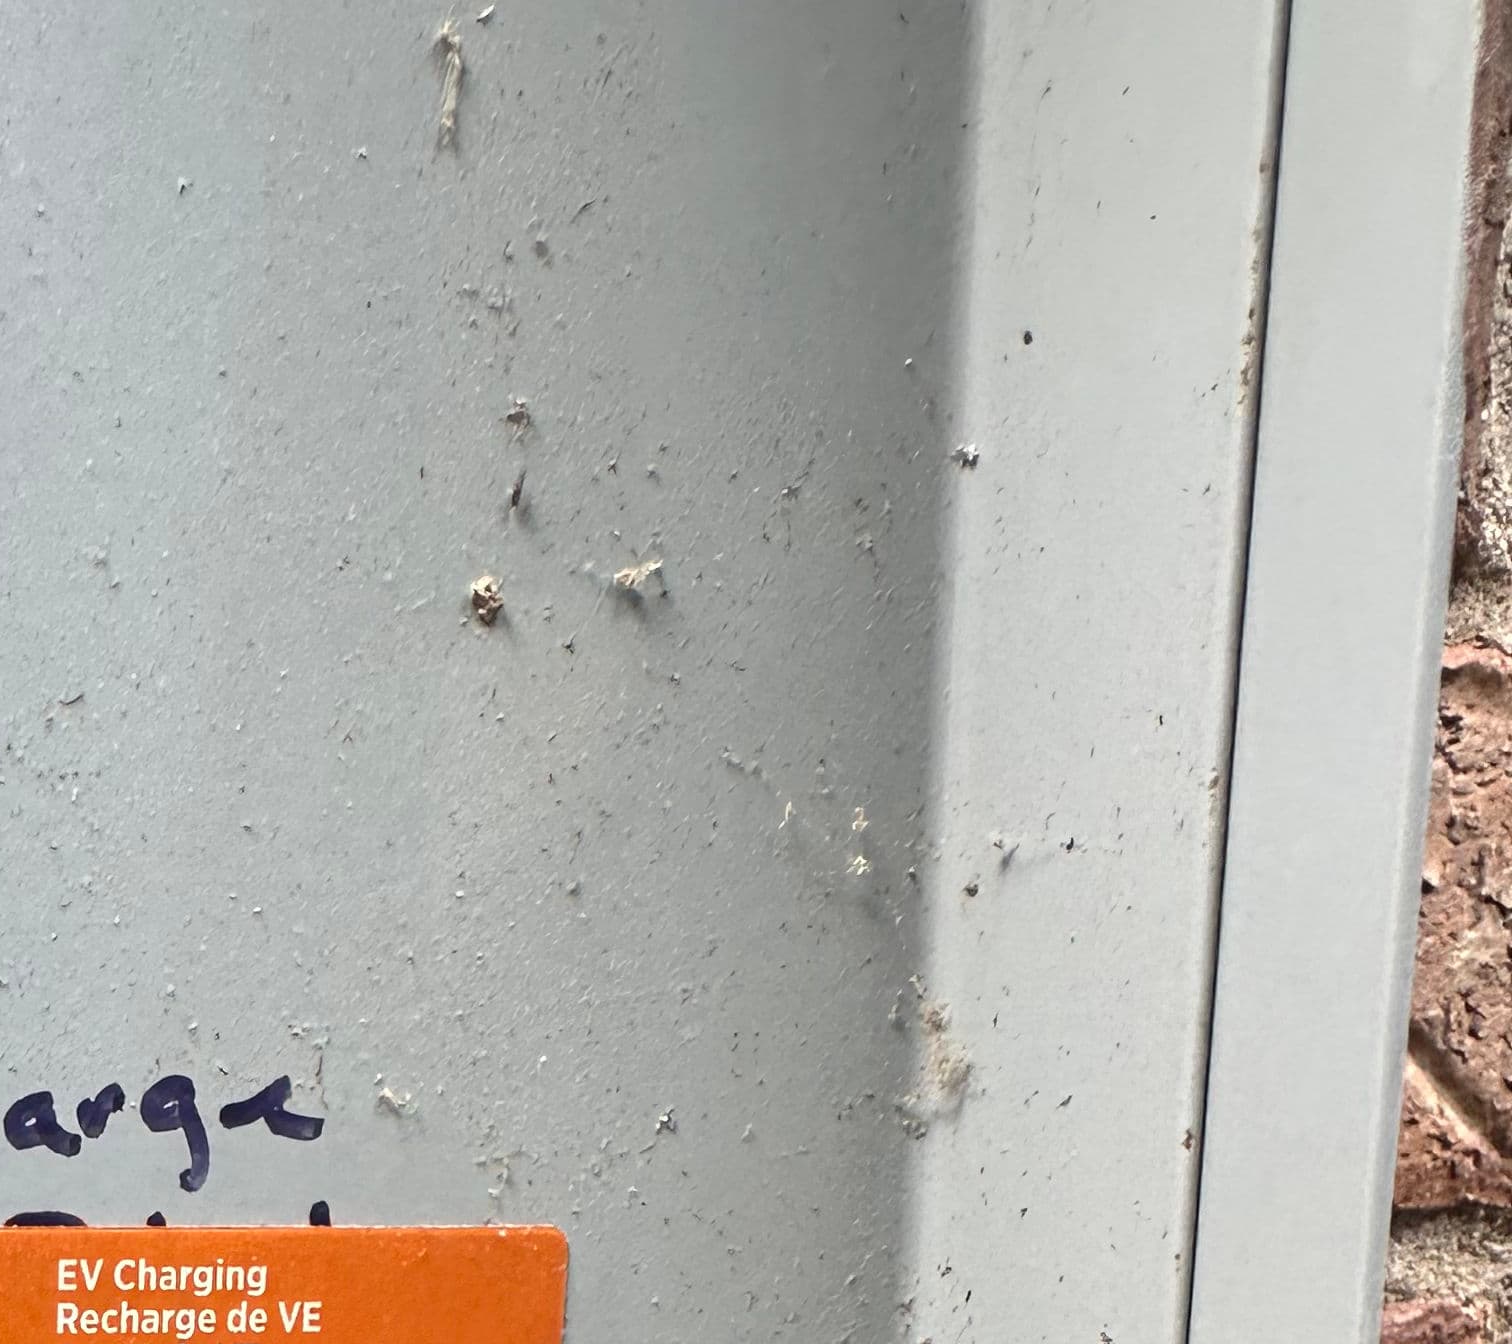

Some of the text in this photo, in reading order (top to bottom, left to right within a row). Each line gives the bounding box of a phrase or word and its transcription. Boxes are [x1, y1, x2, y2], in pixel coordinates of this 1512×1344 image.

[57, 1258, 268, 1298] EV Charging
[56, 1301, 323, 1340] Recharge de VE
